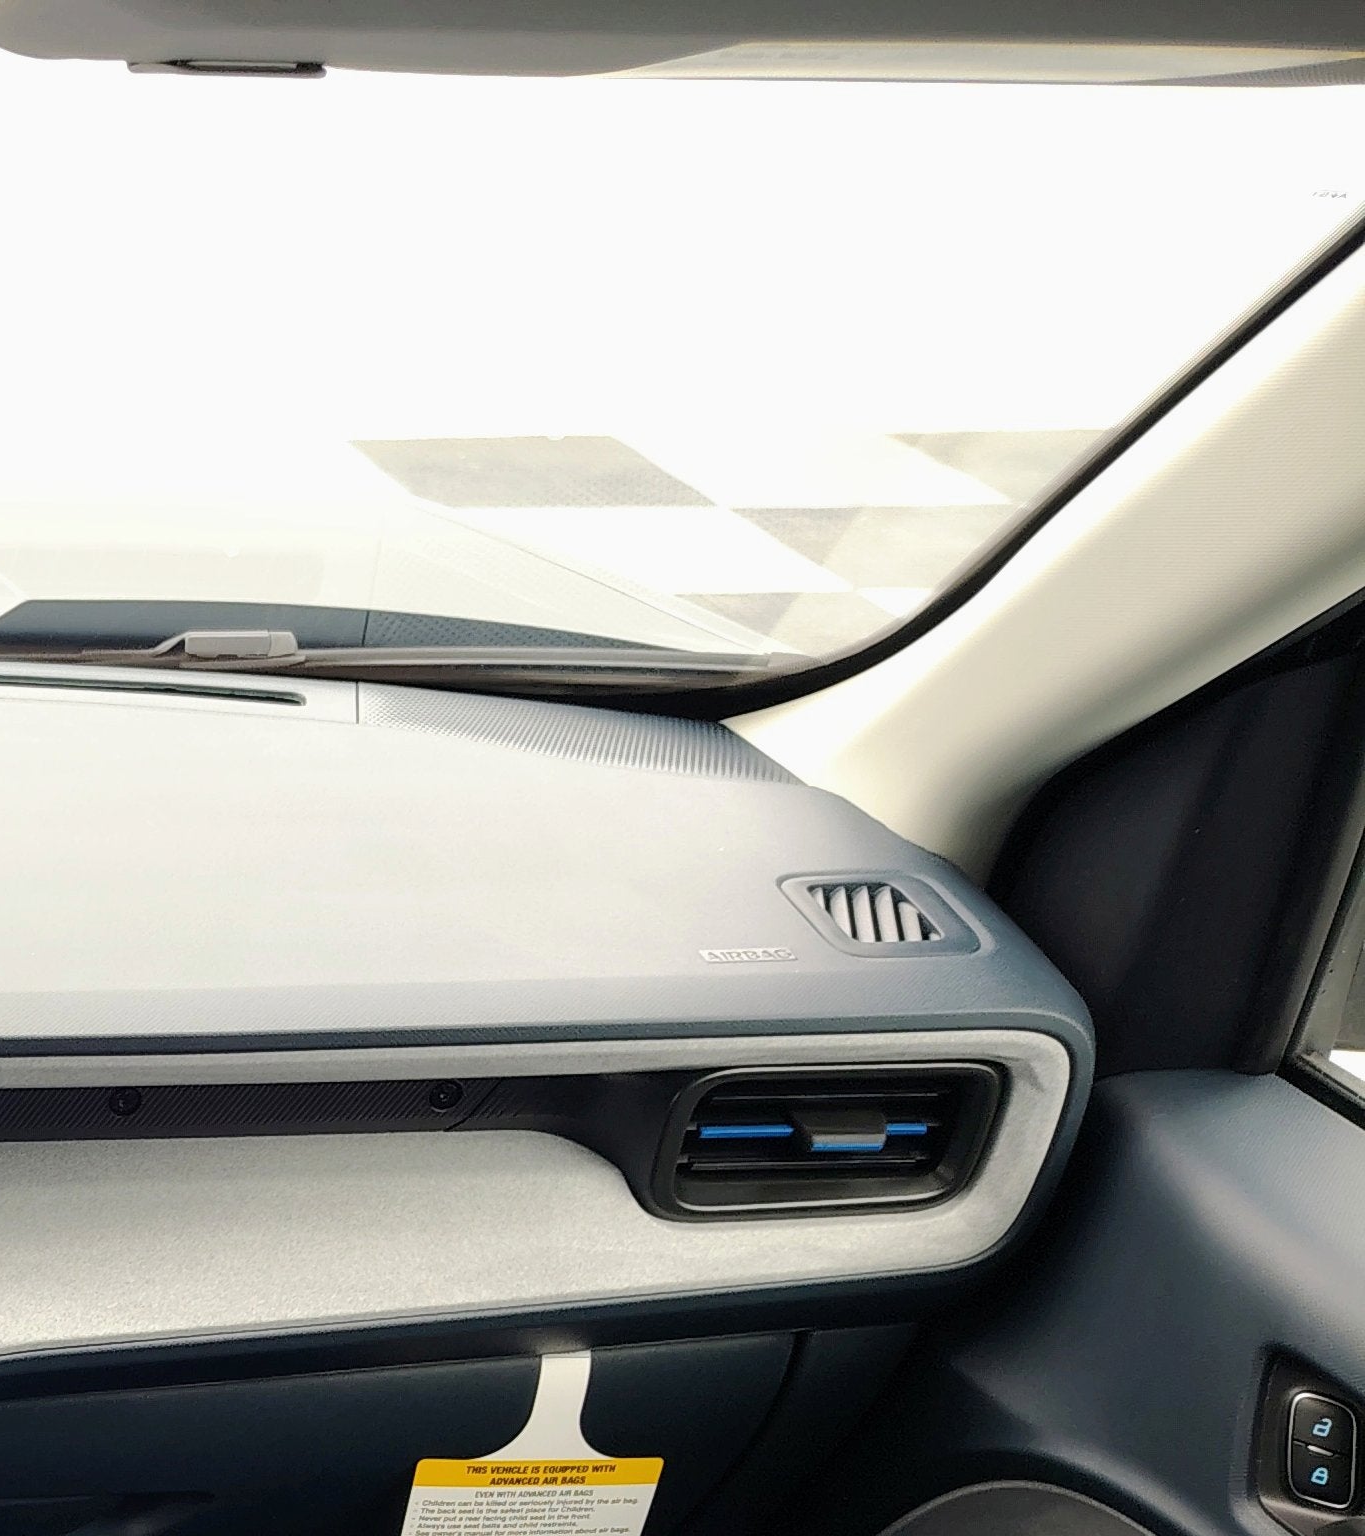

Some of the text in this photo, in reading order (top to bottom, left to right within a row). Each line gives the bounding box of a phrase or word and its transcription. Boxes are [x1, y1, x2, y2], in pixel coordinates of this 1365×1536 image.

[706, 949, 792, 961] AIRBAG
[466, 1464, 617, 1475] THIS VEHICLE IS EQUIPPED WITH
[489, 1476, 587, 1486] ADVANCED AIR BAGS
[474, 1491, 495, 1499] EVEN
[517, 1490, 557, 1498] ADVANCED
[559, 1489, 572, 1497] AIR
[573, 1489, 595, 1497] BAGS
